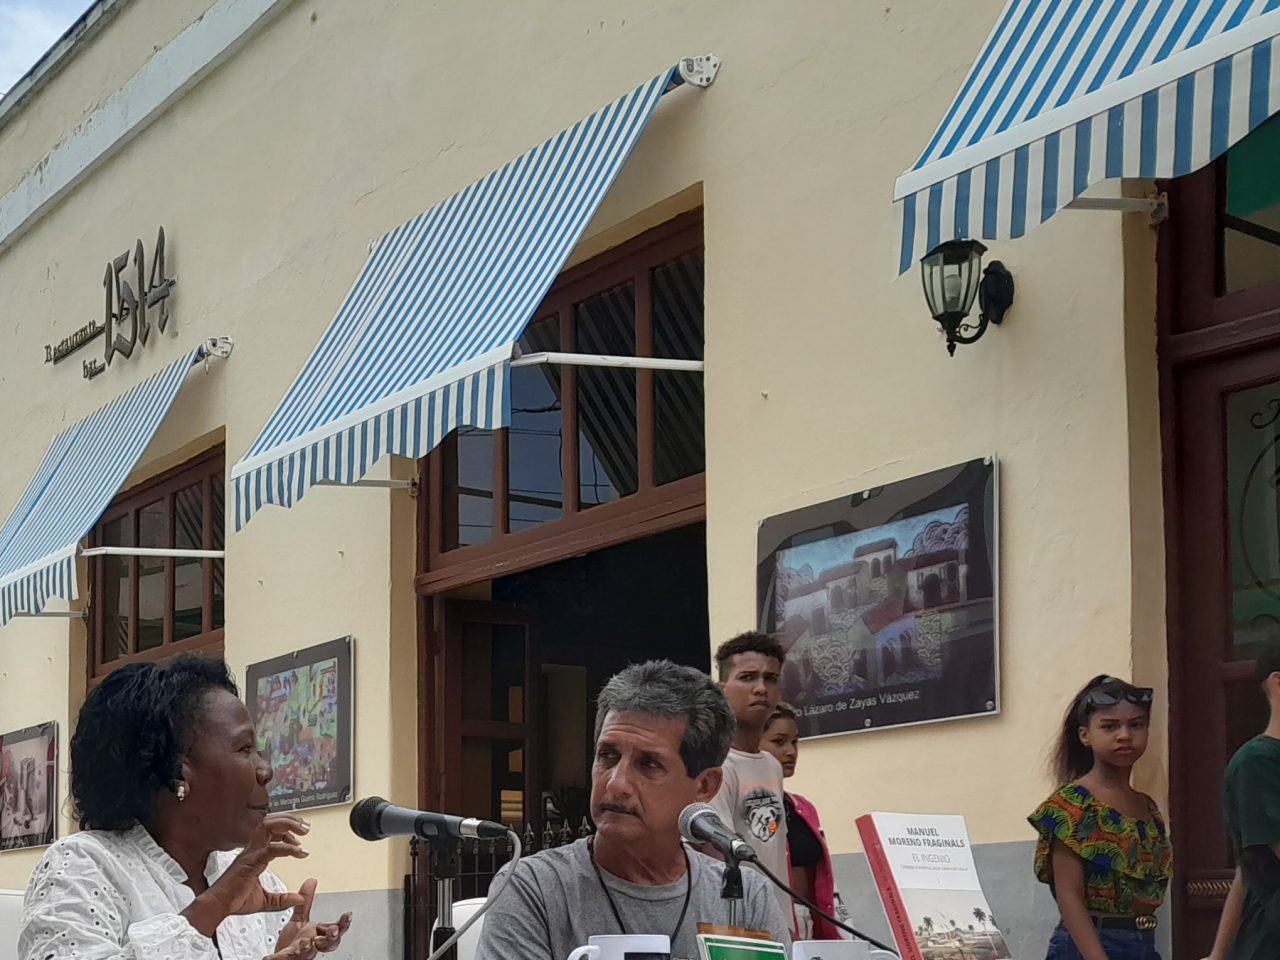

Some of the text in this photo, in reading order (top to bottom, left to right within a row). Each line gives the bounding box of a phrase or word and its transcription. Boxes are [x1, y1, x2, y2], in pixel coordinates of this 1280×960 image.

[103, 225, 177, 367] 1514
[44, 319, 97, 365] Restaurante
[82, 358, 98, 379] bar
[804, 702, 834, 716] Lázaro
[835, 700, 848, 711] de
[849, 696, 878, 710] Zayas
[879, 689, 921, 705] Vázquez
[906, 827, 939, 837] MANUEL
[888, 837, 965, 849] MORENO FRAGINALS
[911, 853, 951, 864] EL INGENIO
